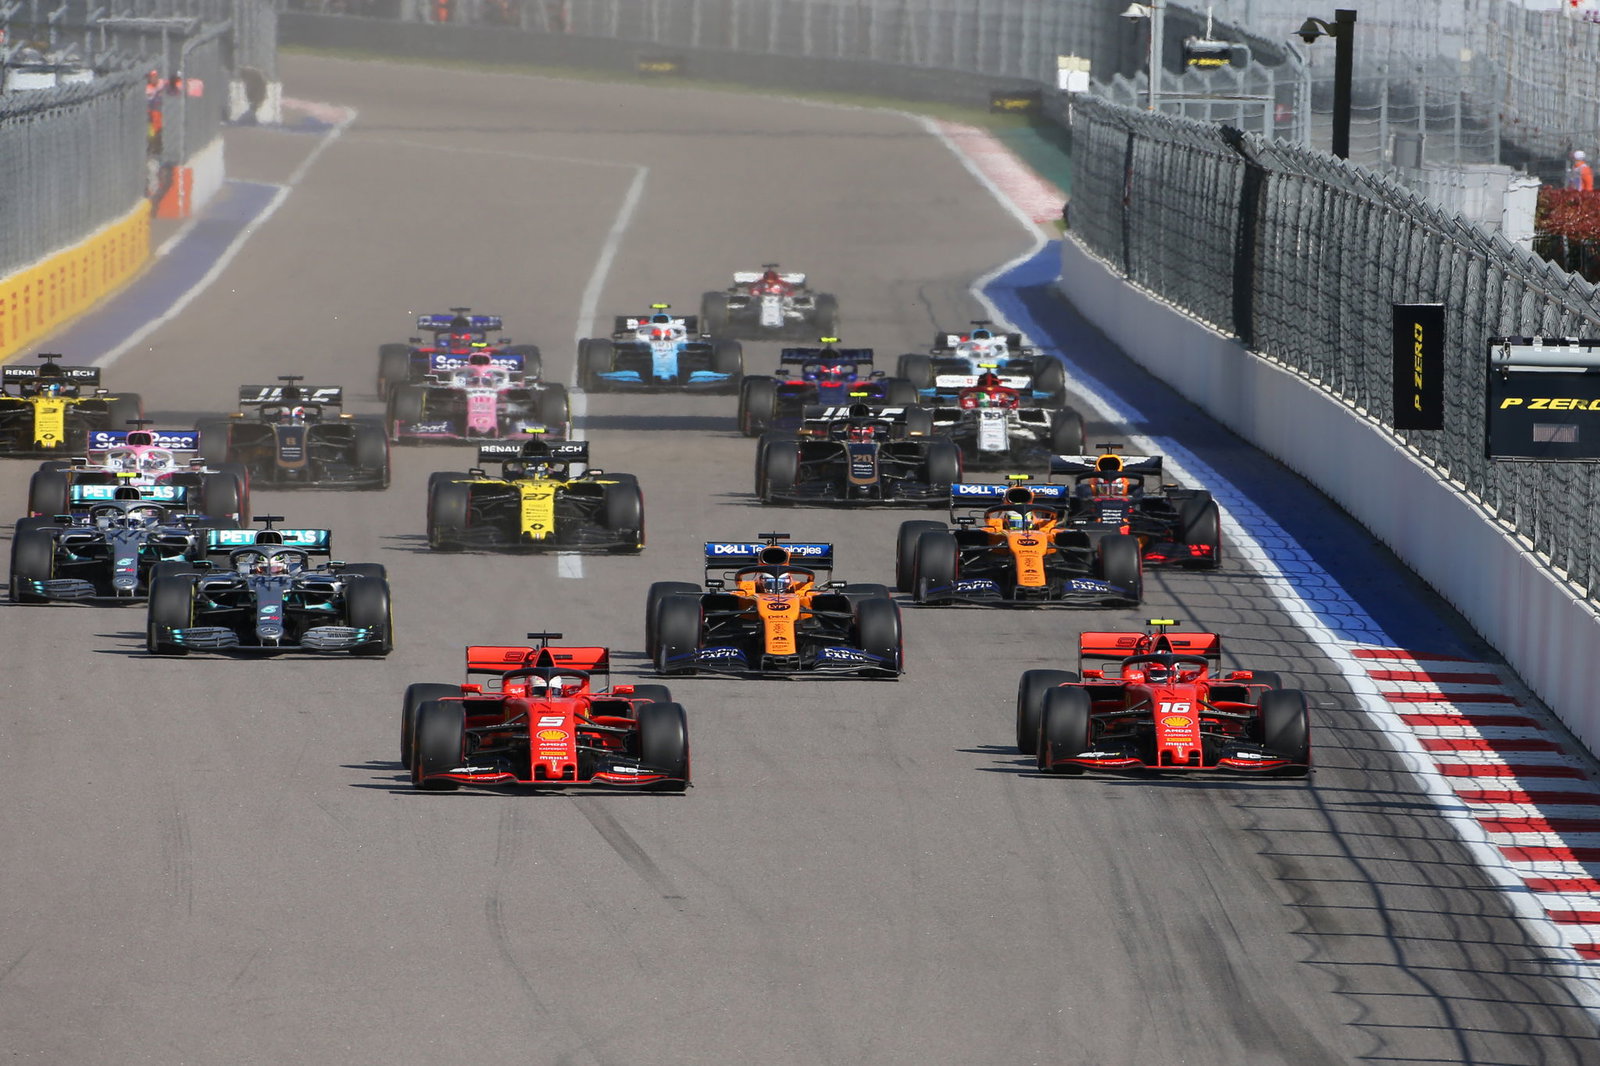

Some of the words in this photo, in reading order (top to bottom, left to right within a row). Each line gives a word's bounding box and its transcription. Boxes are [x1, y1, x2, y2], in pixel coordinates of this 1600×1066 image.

[1414, 323, 1423, 390] ZERO
[1500, 398, 1523, 409] P
[959, 485, 992, 495] DELL
[523, 493, 552, 501] 27
[714, 544, 749, 555] DELL
[1159, 702, 1191, 713] 16
[537, 716, 566, 727] 5
